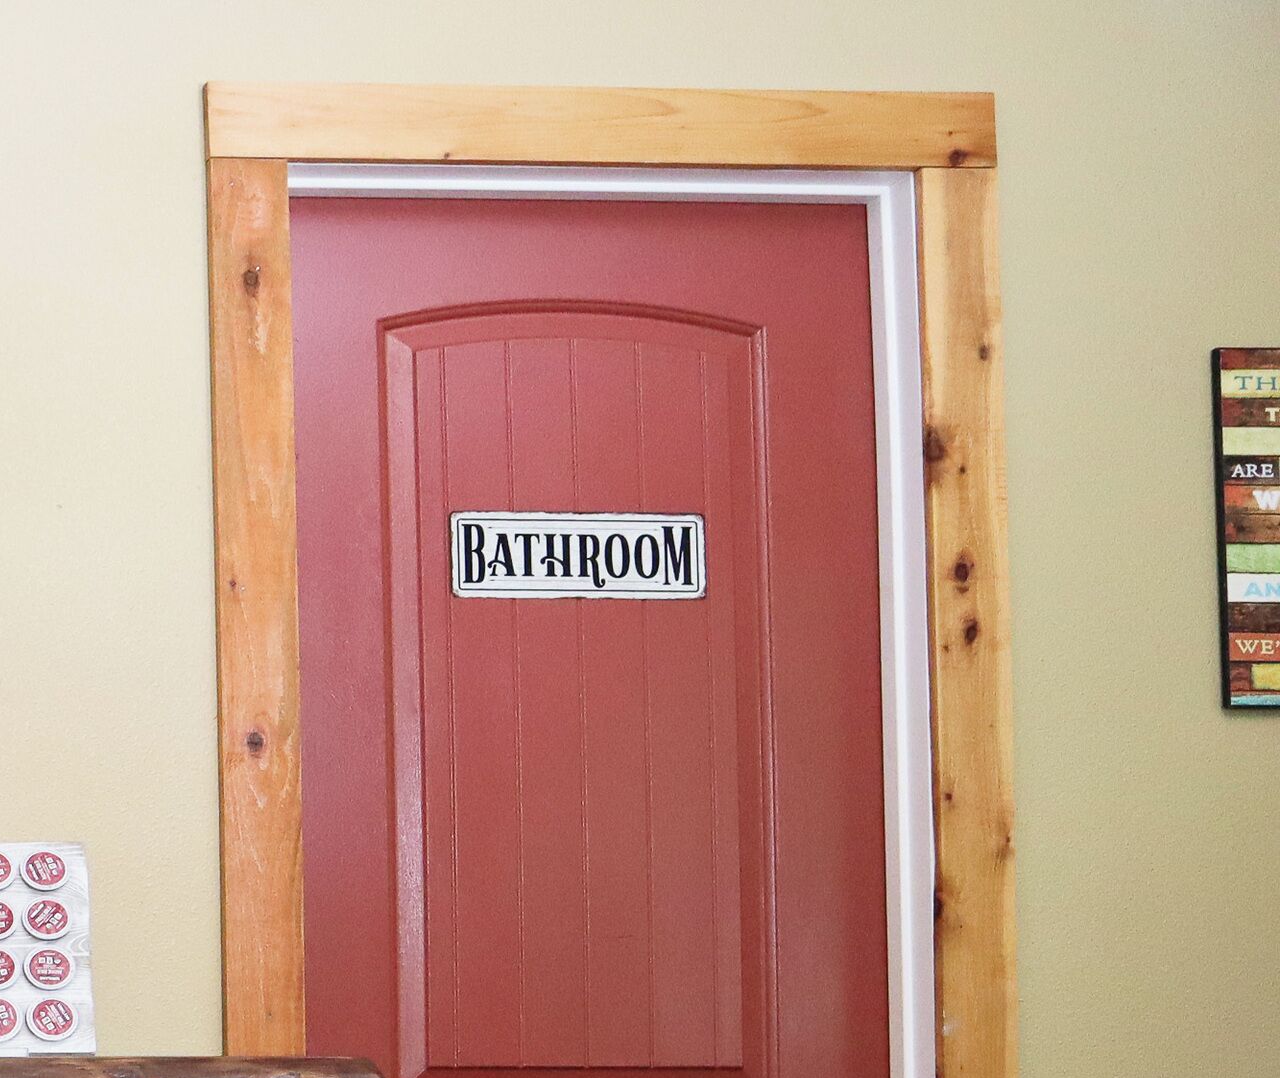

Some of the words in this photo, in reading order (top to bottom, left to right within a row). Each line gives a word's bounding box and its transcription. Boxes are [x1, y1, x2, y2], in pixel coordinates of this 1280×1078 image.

[1234, 376, 1280, 390] TH
[1231, 464, 1274, 478] ARE
[461, 523, 694, 588] BATHROOM
